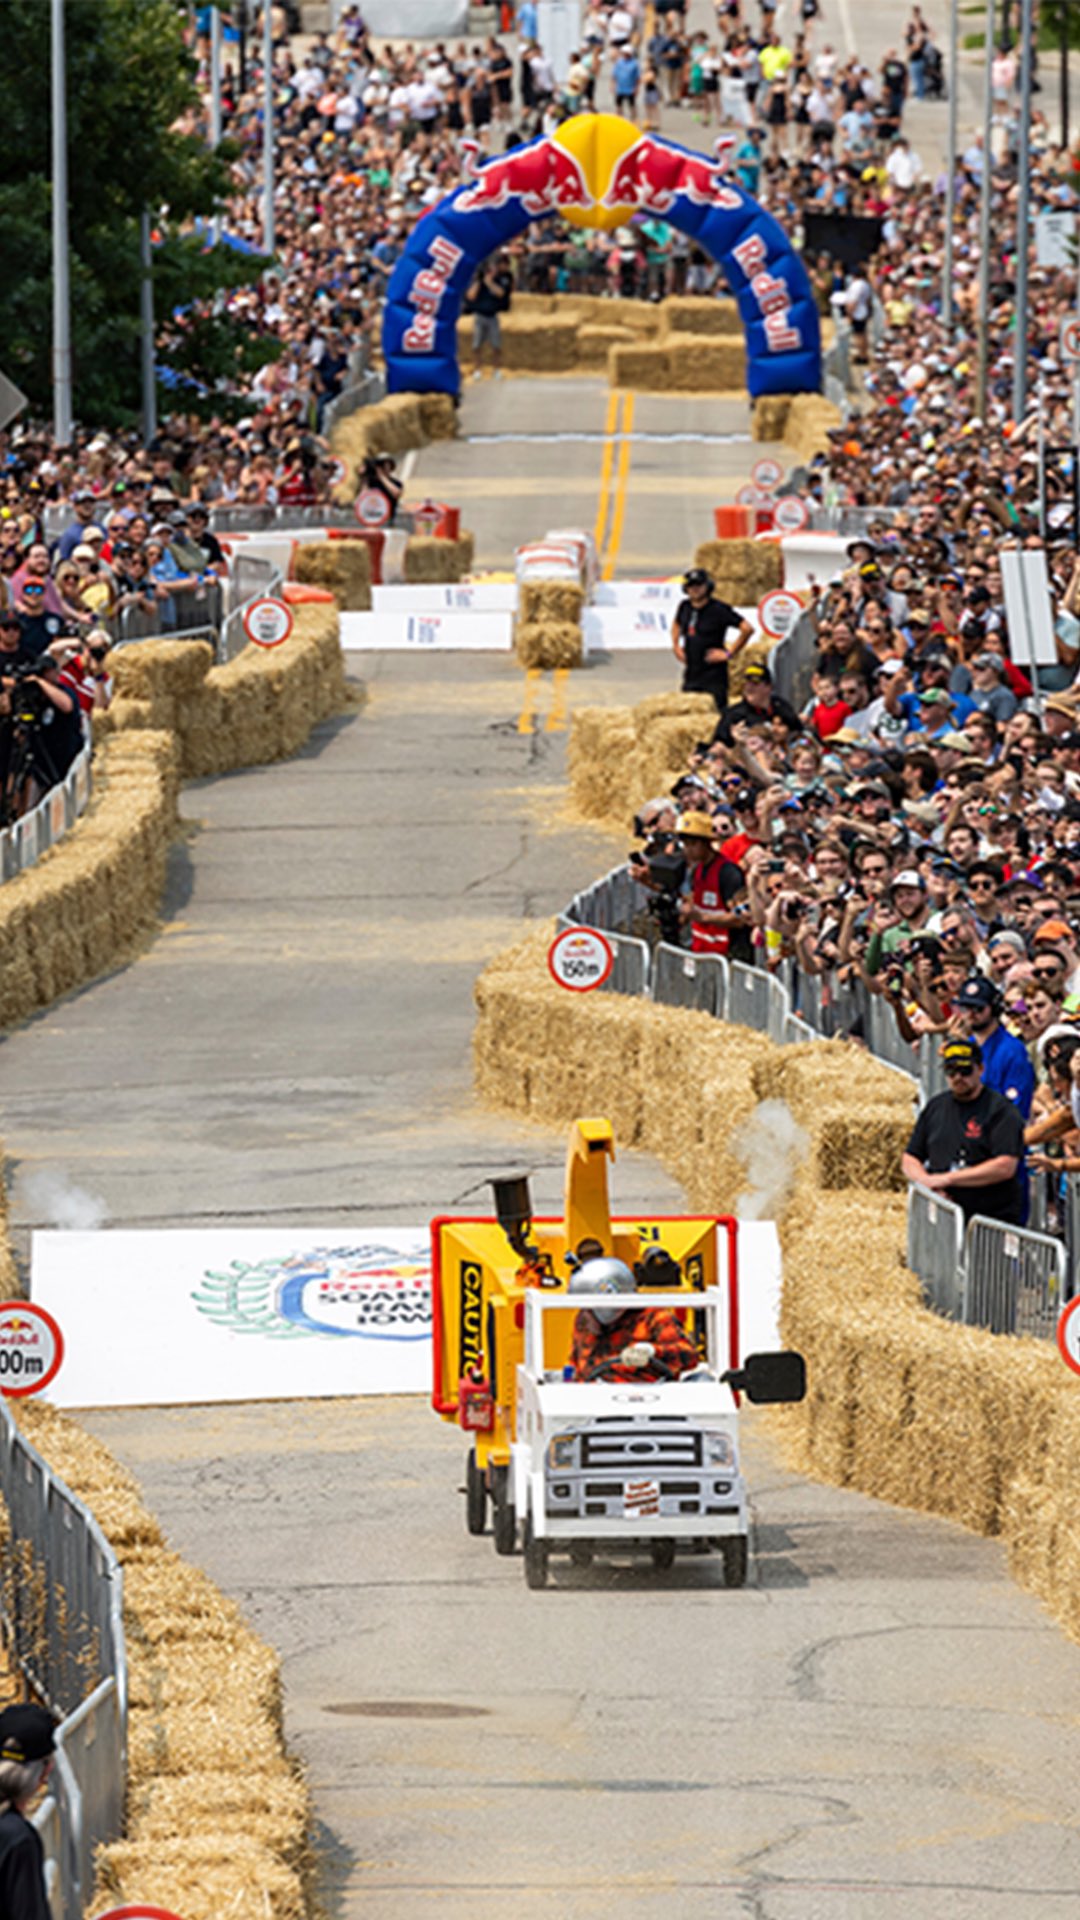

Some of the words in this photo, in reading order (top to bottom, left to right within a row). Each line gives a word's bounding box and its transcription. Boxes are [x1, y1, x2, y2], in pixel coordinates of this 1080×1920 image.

[562, 960, 600, 978] 150m
[362, 1302, 429, 1313] RAC
[358, 1313, 433, 1324] IOW
[0, 1350, 43, 1374] 00m
